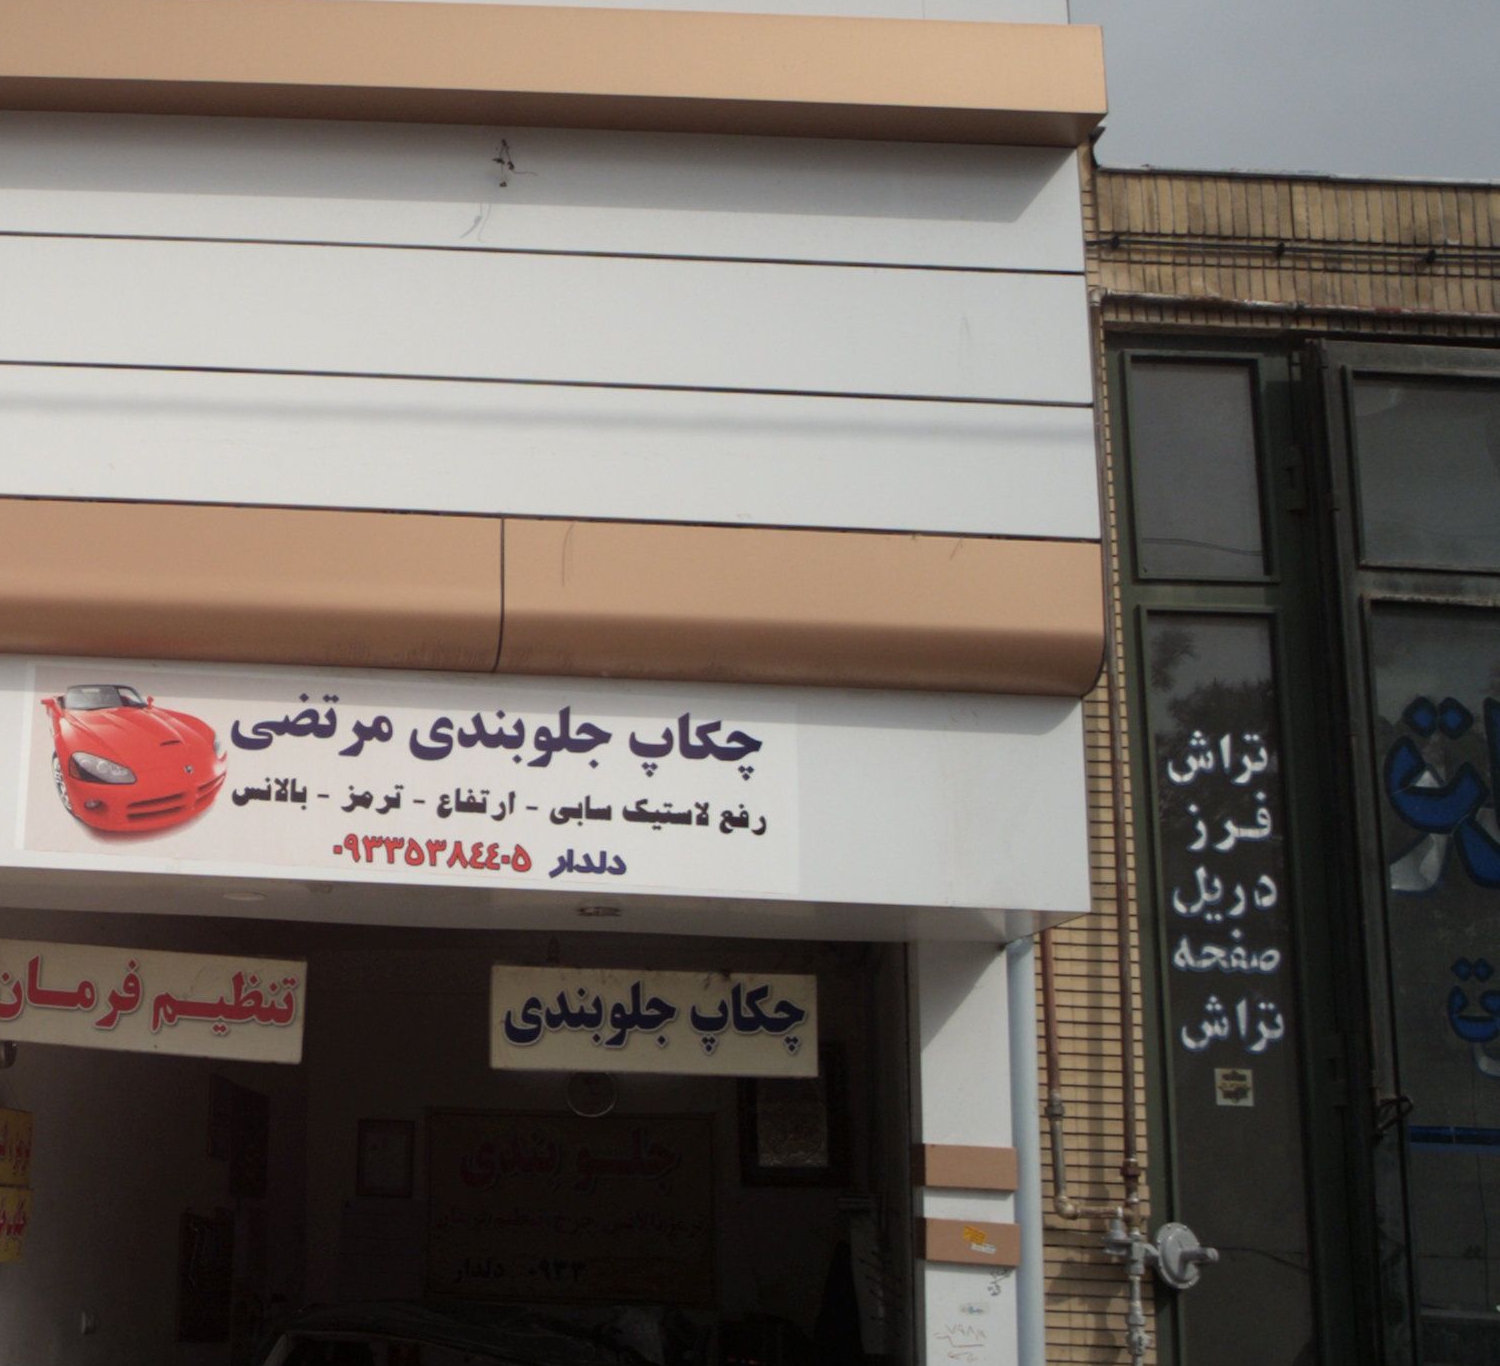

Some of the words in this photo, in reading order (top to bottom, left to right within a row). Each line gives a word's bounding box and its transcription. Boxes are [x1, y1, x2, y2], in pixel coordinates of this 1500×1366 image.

[230, 692, 394, 758] مرتضی
[409, 705, 613, 769] جلوبندی
[629, 712, 763, 781] چکاپ
[1167, 729, 1269, 785] تراش
[231, 777, 308, 811] بالانس
[341, 784, 404, 815] ترمز
[436, 788, 516, 822] ارتفاع
[549, 795, 612, 827] سابی
[622, 798, 710, 831] لاستیک
[719, 803, 767, 836] رفع
[1188, 791, 1272, 852] فرز
[548, 848, 627, 879] دلدار
[1172, 866, 1278, 922] دریل
[1172, 928, 1281, 972] صفحه
[151, 970, 296, 1033] تنظیم
[504, 979, 677, 1048] جلوبندی
[691, 981, 807, 1053] چکاپ
[1181, 995, 1285, 1052] تراش
